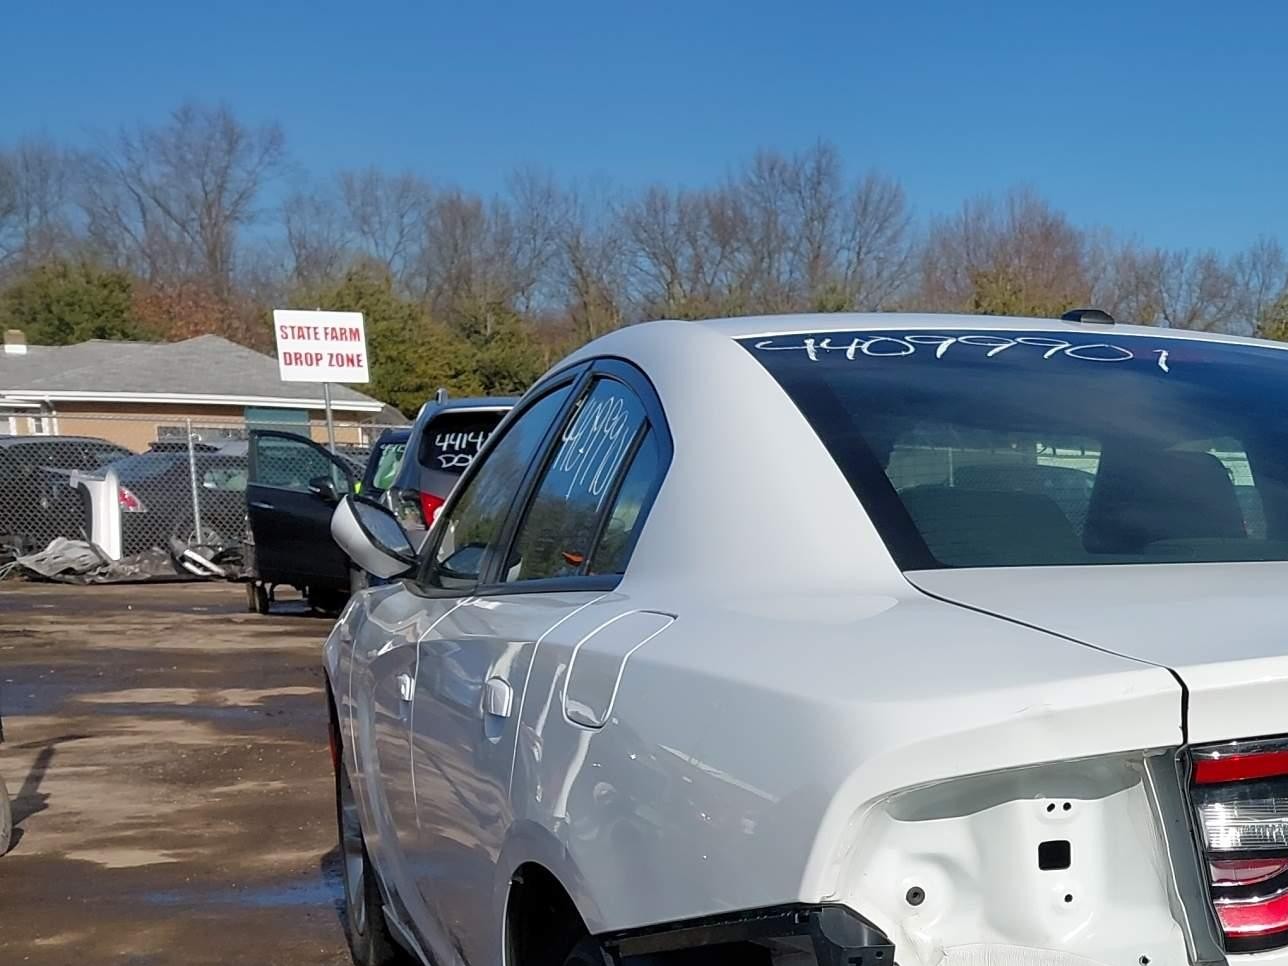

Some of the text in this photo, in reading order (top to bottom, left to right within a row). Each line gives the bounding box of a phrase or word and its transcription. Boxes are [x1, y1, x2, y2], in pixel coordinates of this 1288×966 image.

[279, 325, 361, 342] STATE FARM
[283, 351, 364, 368] DROP ZONE
